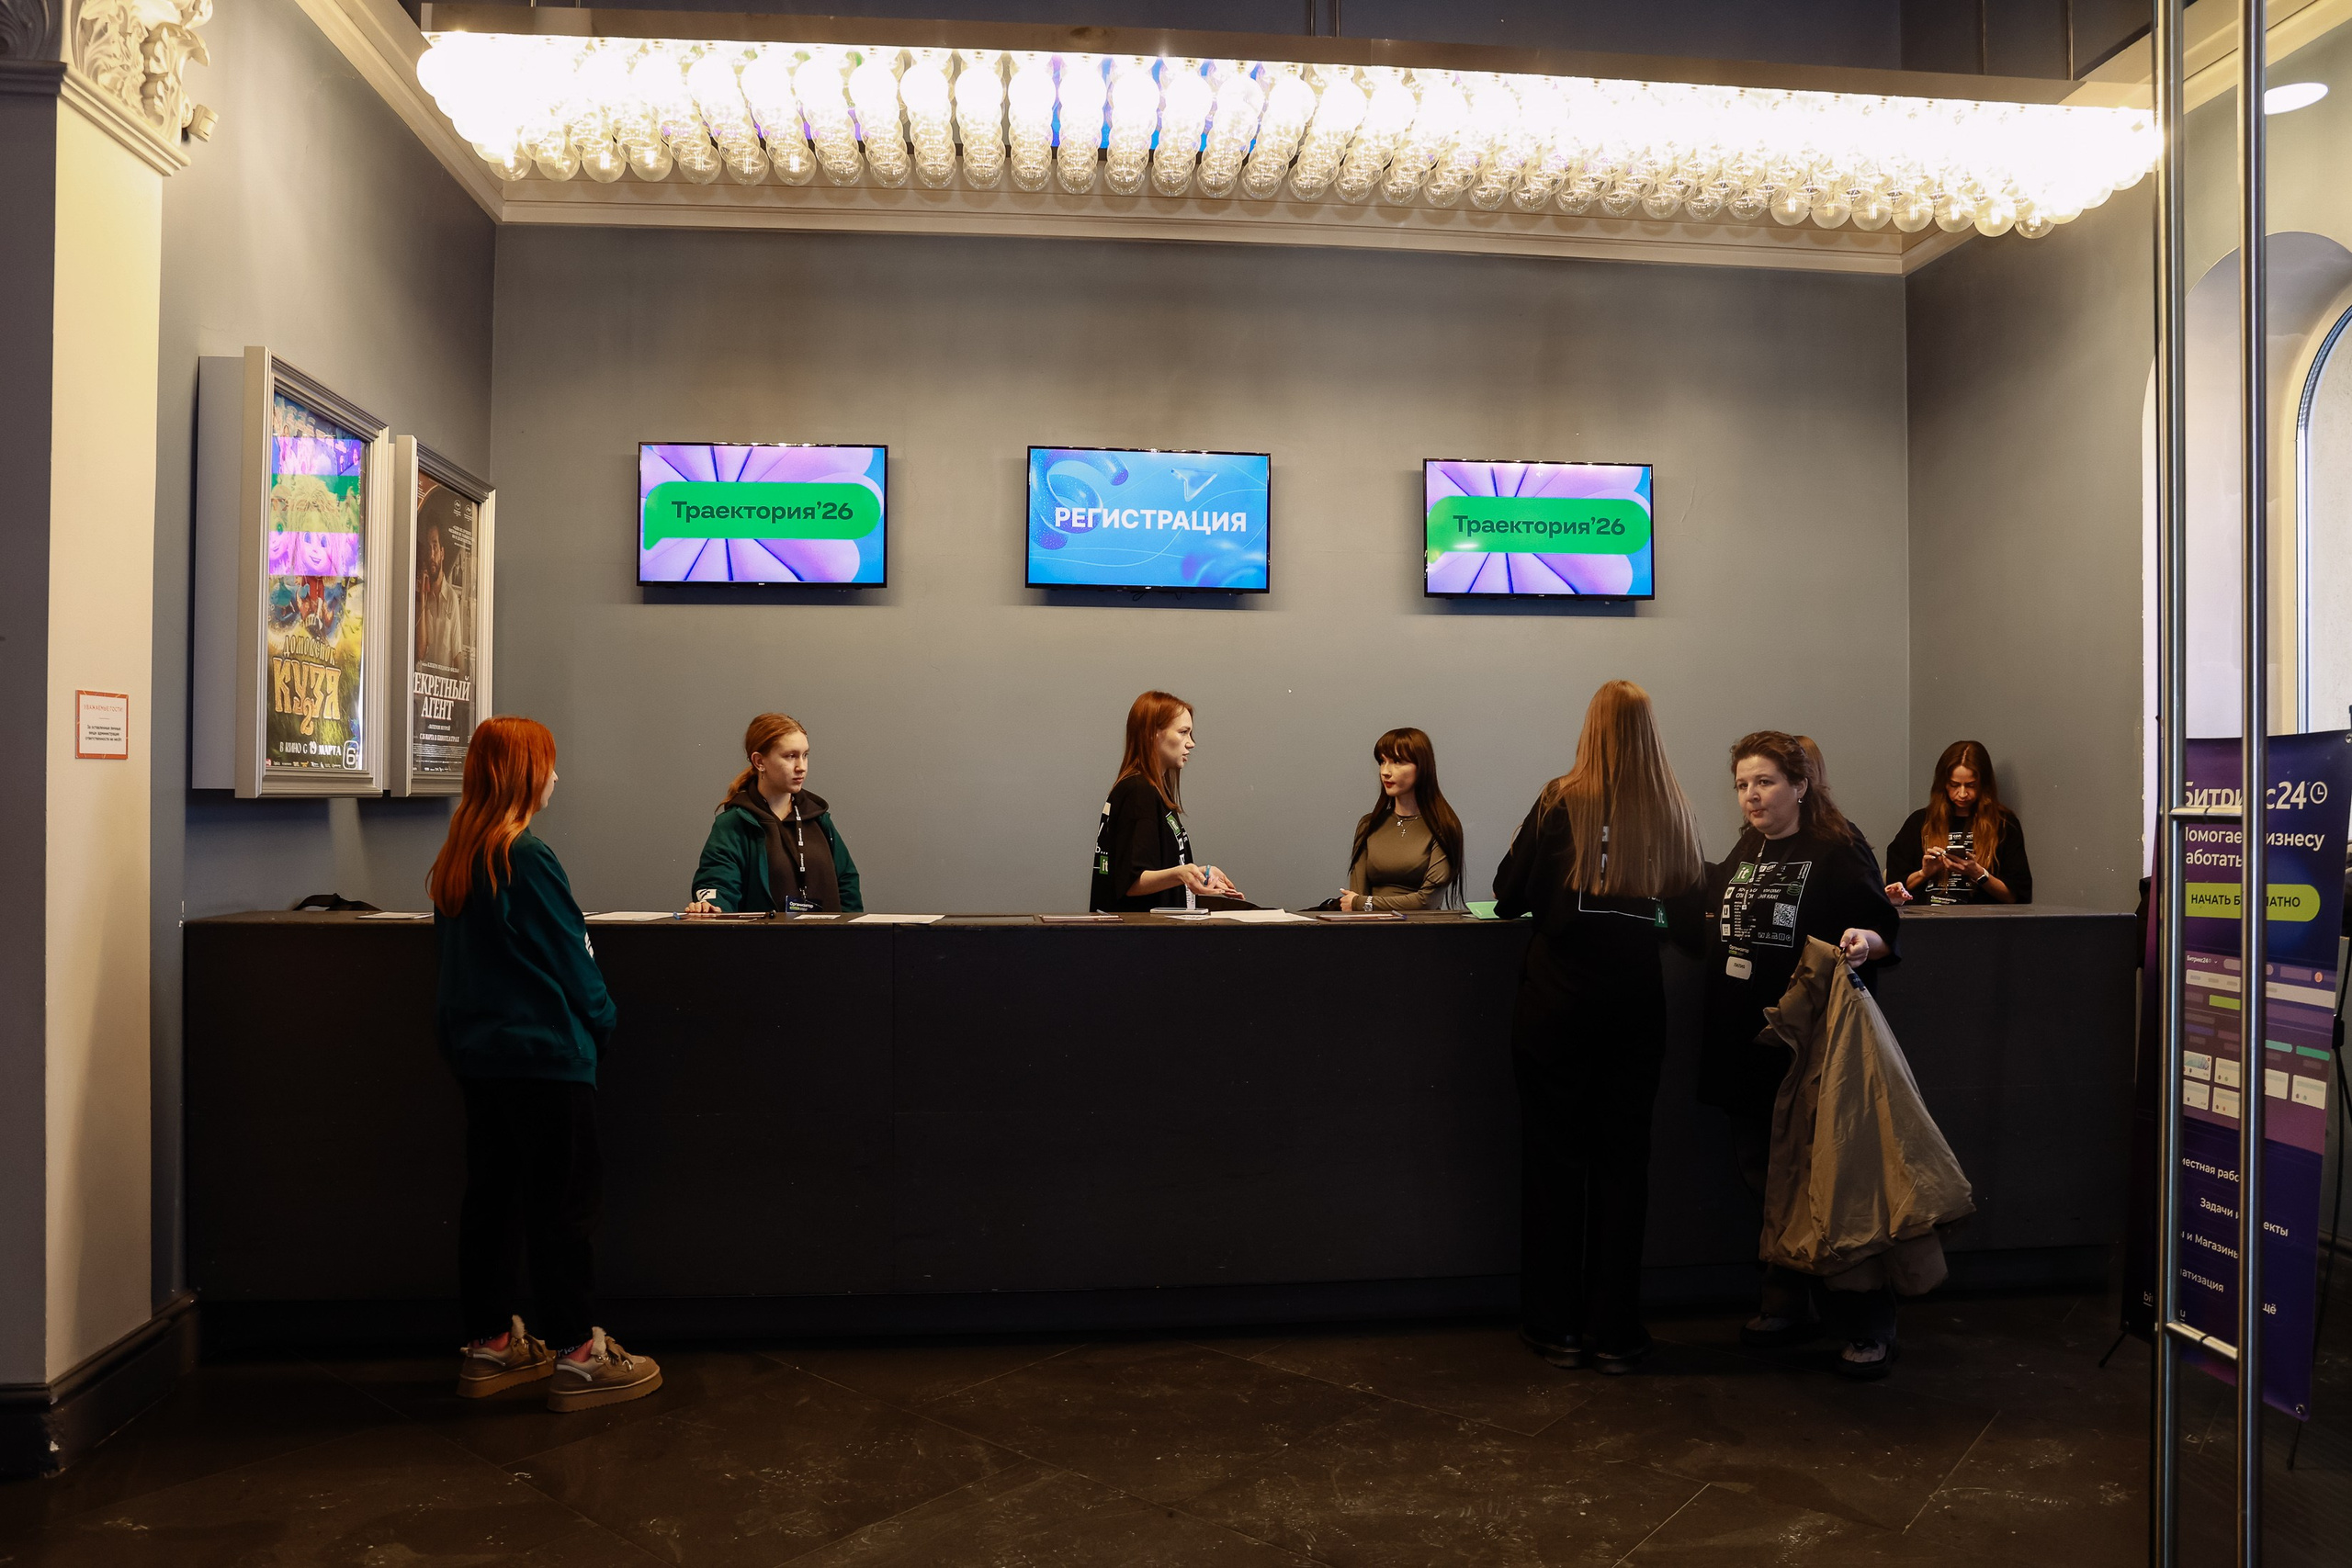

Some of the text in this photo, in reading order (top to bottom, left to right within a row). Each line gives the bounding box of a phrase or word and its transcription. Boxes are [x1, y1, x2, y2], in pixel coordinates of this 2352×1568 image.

[1055, 507, 1247, 535] РЕГИСТРАЦИЯ
[273, 657, 341, 720] КУЗЯ
[413, 671, 471, 701] ЕКРЕТНЫЙ
[421, 696, 455, 720] АГЕНТ
[279, 741, 284, 753] В
[285, 741, 301, 754] КИНО
[309, 740, 317, 755] 19
[318, 744, 342, 756] МАРТА
[2185, 826, 2325, 852] омогае изнесу
[2186, 848, 2243, 867] аботать
[1736, 866, 1751, 879] it
[2190, 894, 2301, 908] НАЧАТЬ БАТНО
[2182, 1157, 2240, 1183] естная рабо
[2199, 1197, 2233, 1217] Задачи
[2263, 1221, 2289, 1237] екты
[2180, 1269, 2224, 1293] атизация
